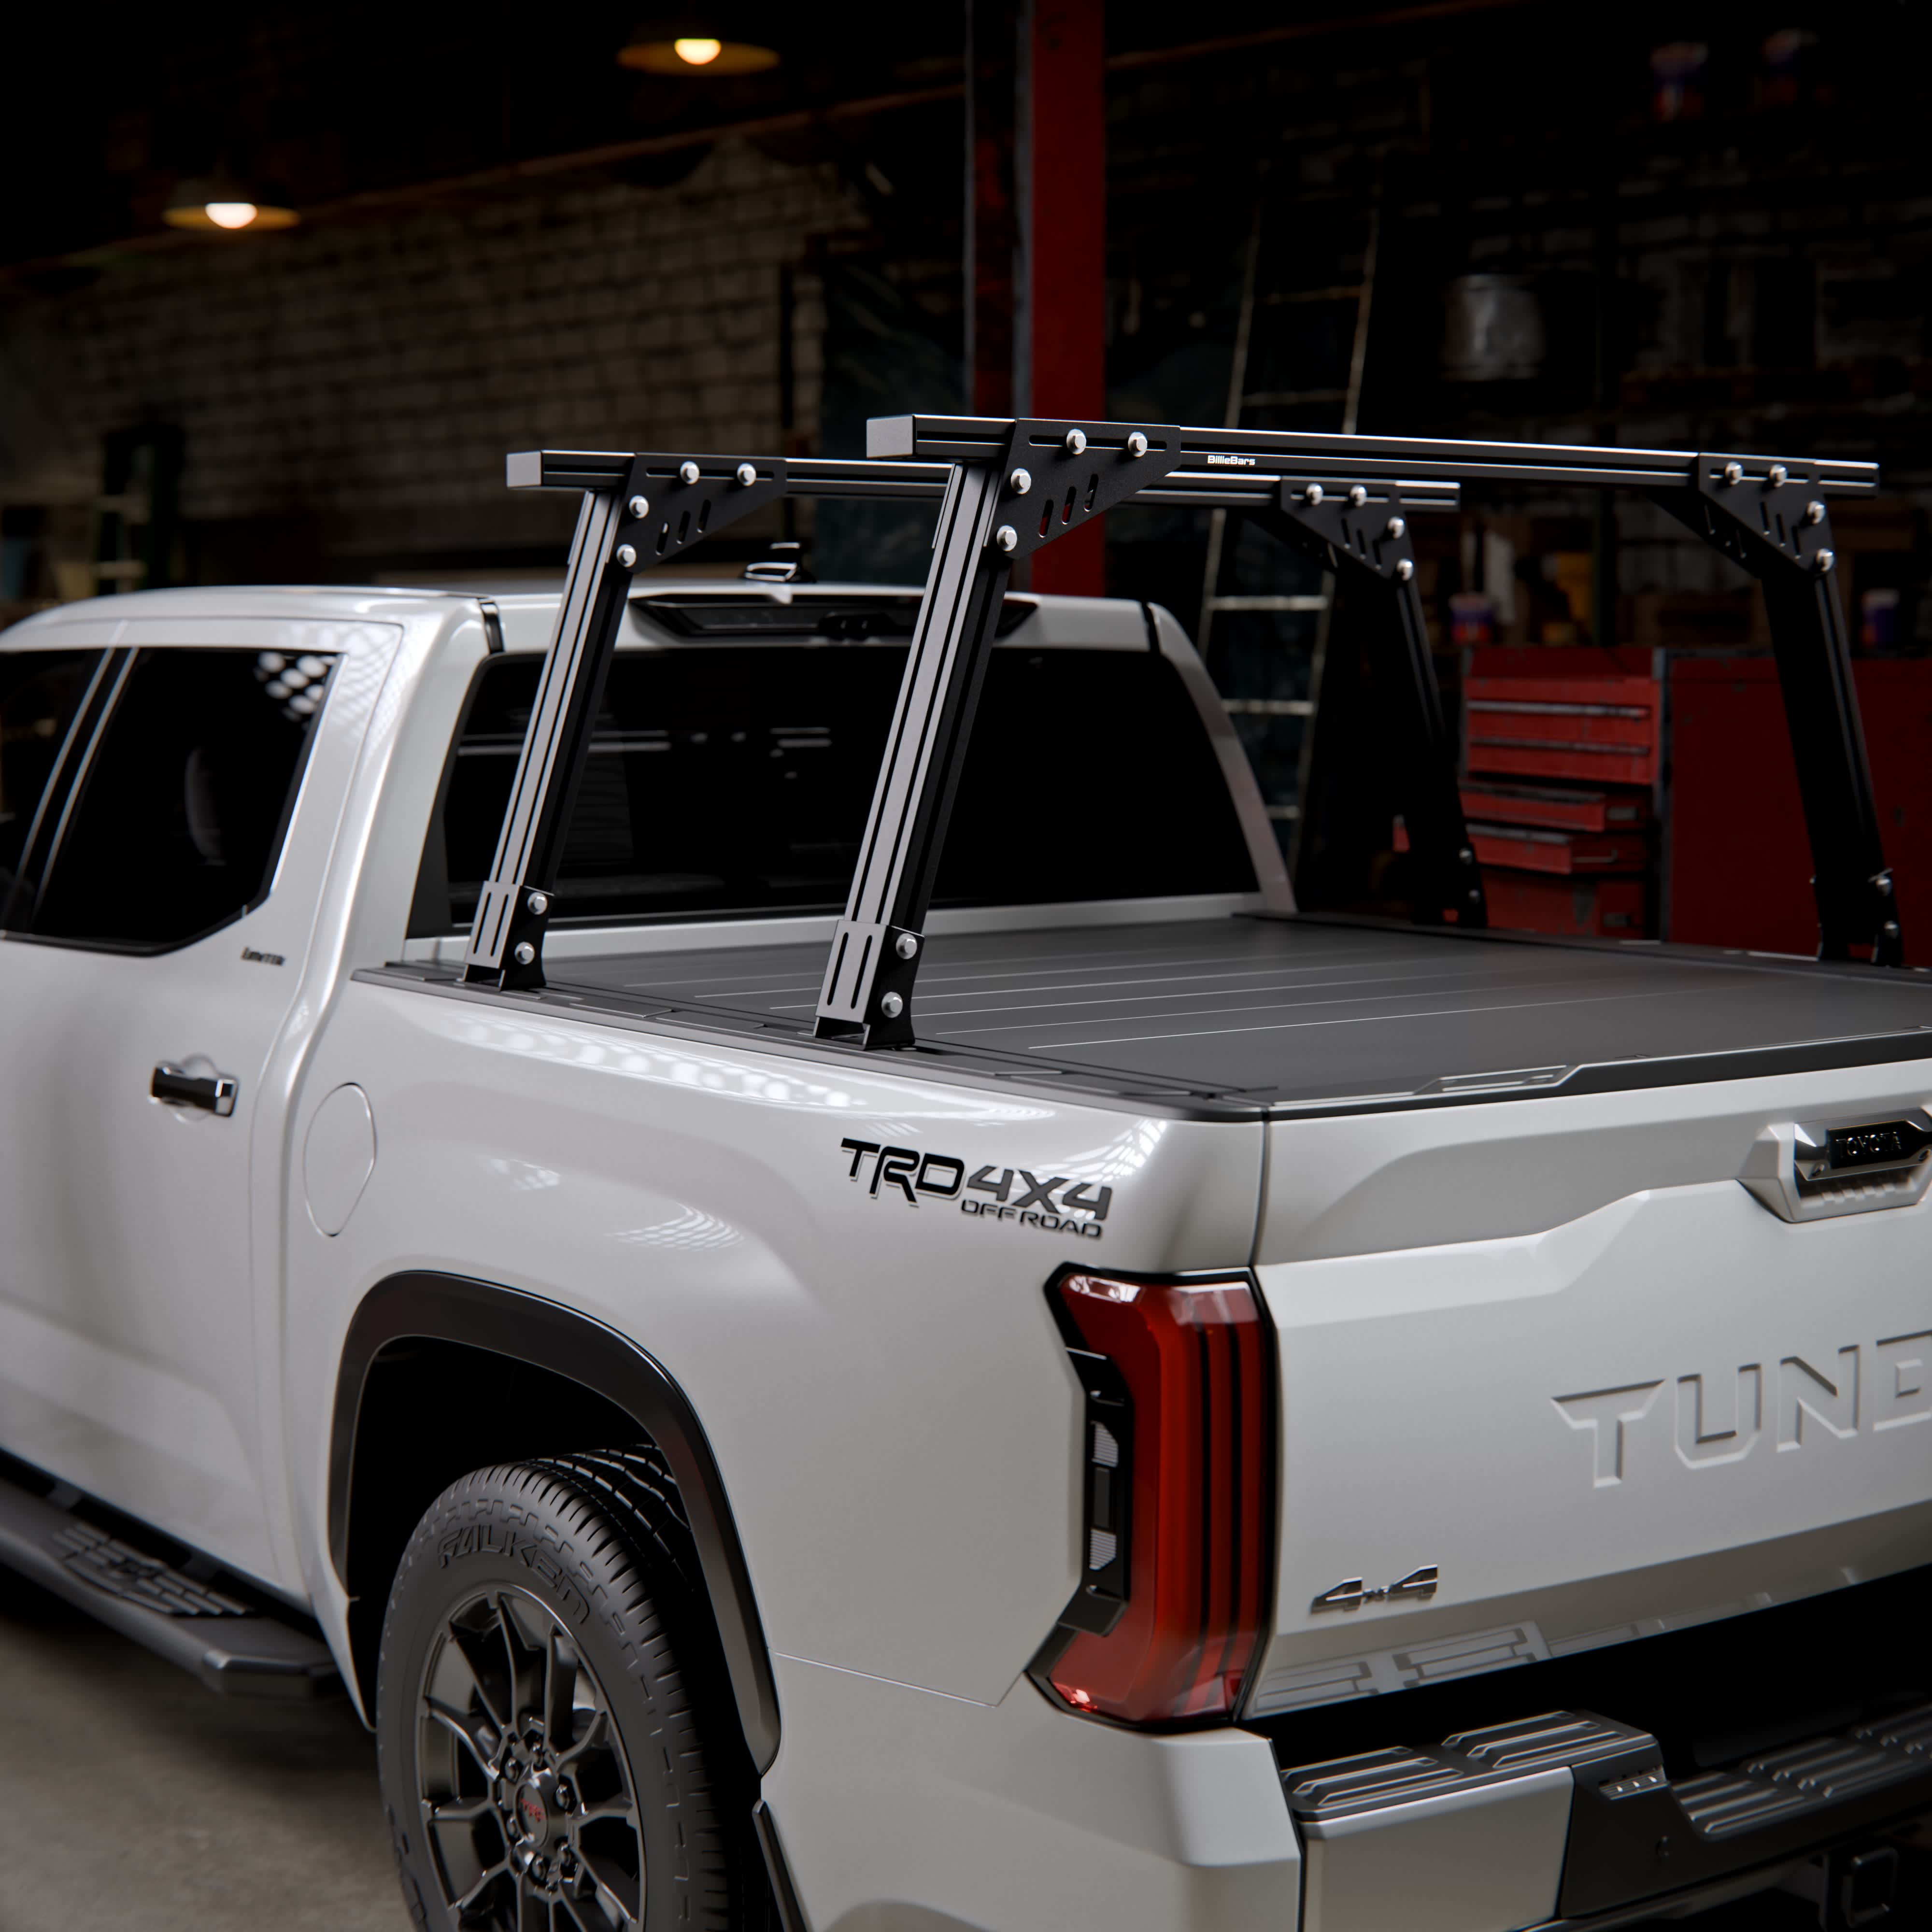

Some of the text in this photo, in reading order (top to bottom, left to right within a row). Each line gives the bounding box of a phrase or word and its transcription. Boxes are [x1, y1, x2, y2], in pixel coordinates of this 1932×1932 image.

[1208, 455, 1255, 466] BillieBars
[1835, 1132, 1902, 1157] TOYOTA
[840, 1137, 965, 1206] TRD
[961, 1199, 1102, 1239] OFF ROAD
